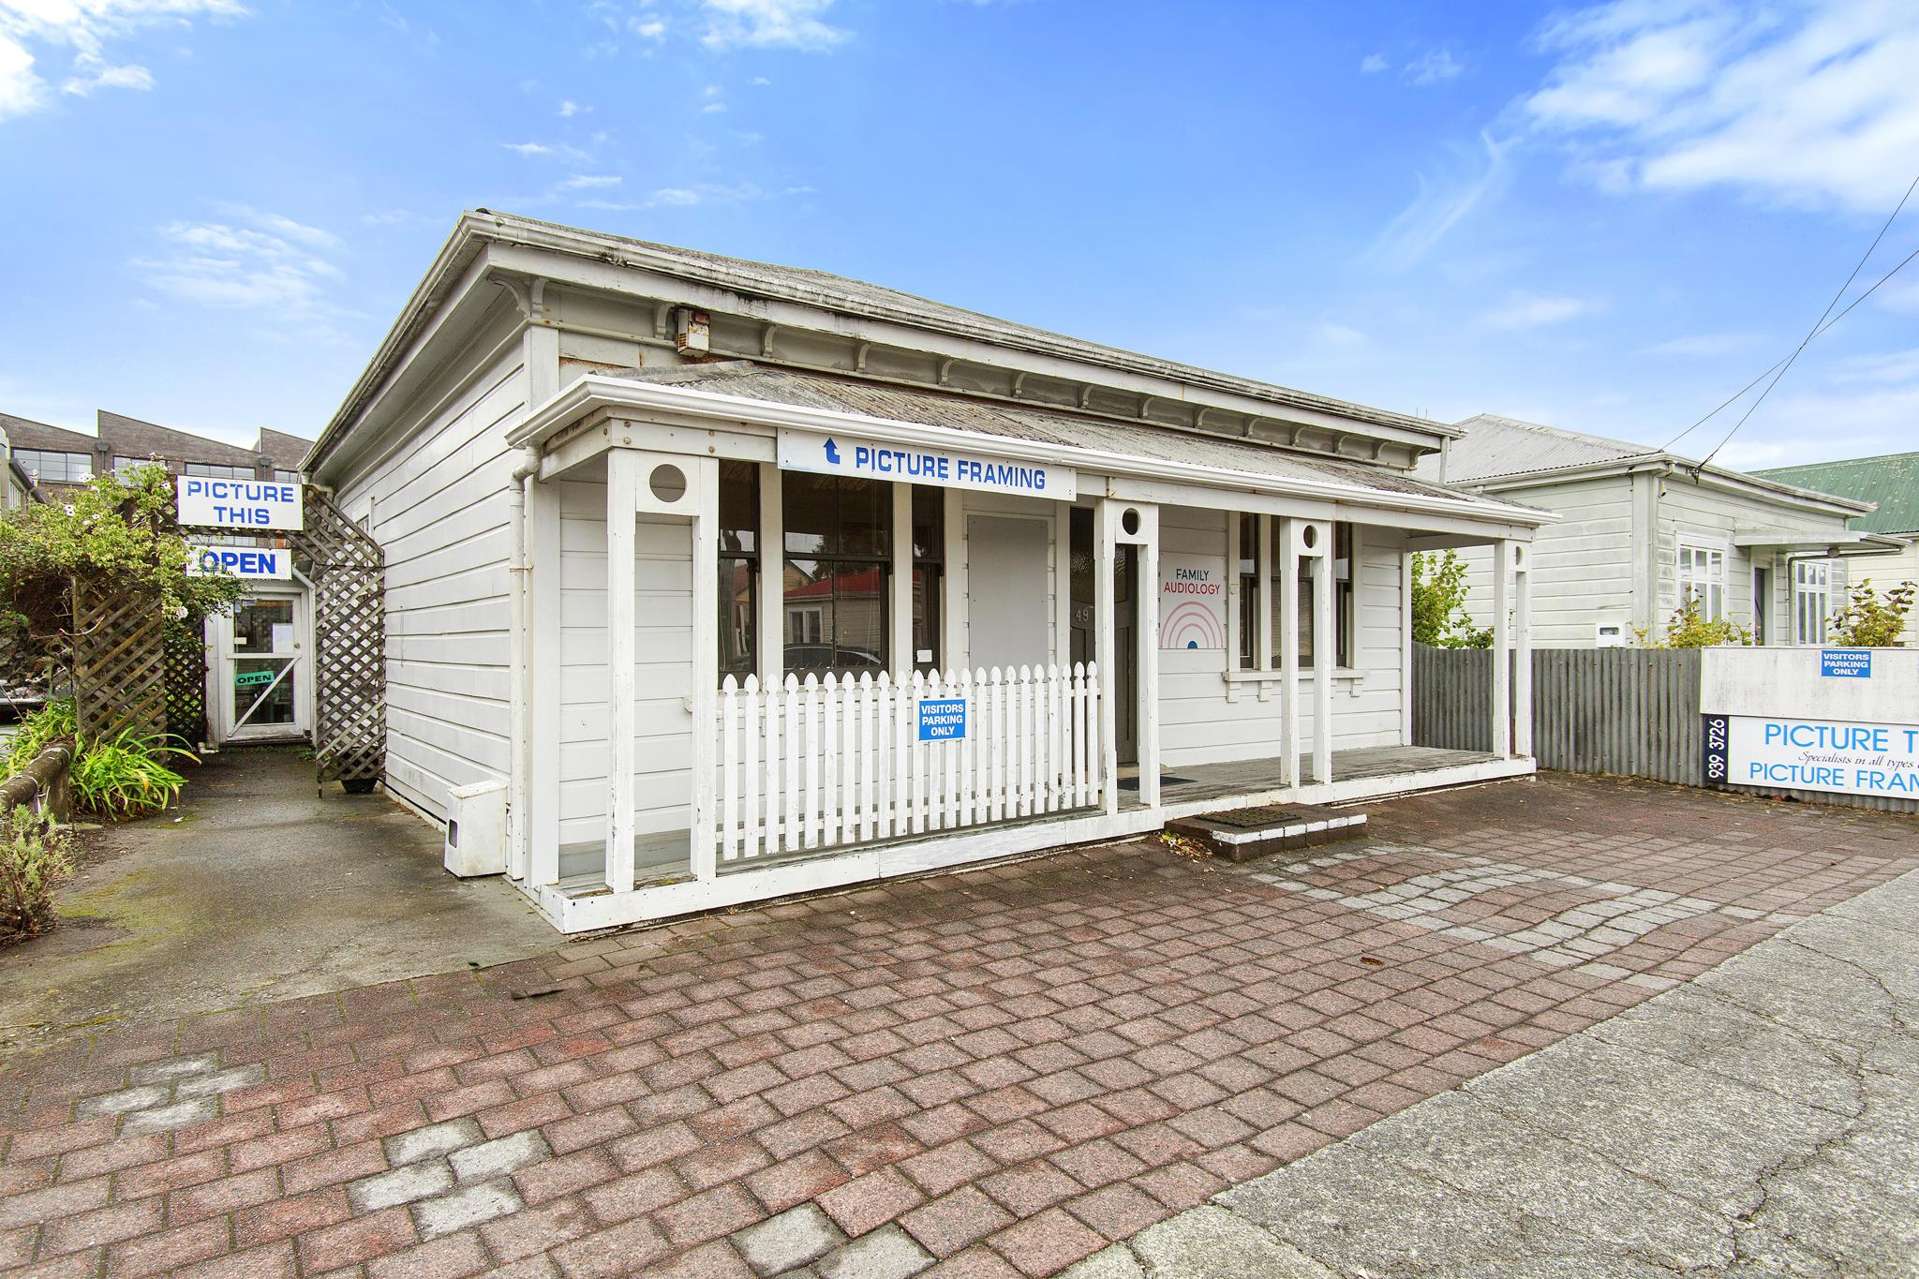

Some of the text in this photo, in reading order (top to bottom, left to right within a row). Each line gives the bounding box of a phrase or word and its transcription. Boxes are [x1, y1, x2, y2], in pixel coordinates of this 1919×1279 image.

[855, 446, 1046, 490] PICTURE FRAMING
[187, 480, 294, 503] PICTURE
[213, 506, 271, 525] THIS
[201, 551, 276, 574] OPEN
[1176, 568, 1210, 581] FAMILY
[1163, 582, 1220, 595] AUDIOLOGY
[1074, 607, 1089, 622] 49
[1823, 660, 1869, 668] PARKING
[237, 674, 272, 684] OPEN
[1832, 668, 1859, 676] ONLY
[921, 704, 964, 715] VISITORS
[922, 715, 963, 725] PARKING
[930, 726, 955, 737] ONLY
[1765, 723, 1889, 752] PICTURE
[1708, 719, 1725, 778] 939 3726
[1798, 750, 1914, 771] Specialists in all types
[1749, 762, 1845, 787] PICTURE
